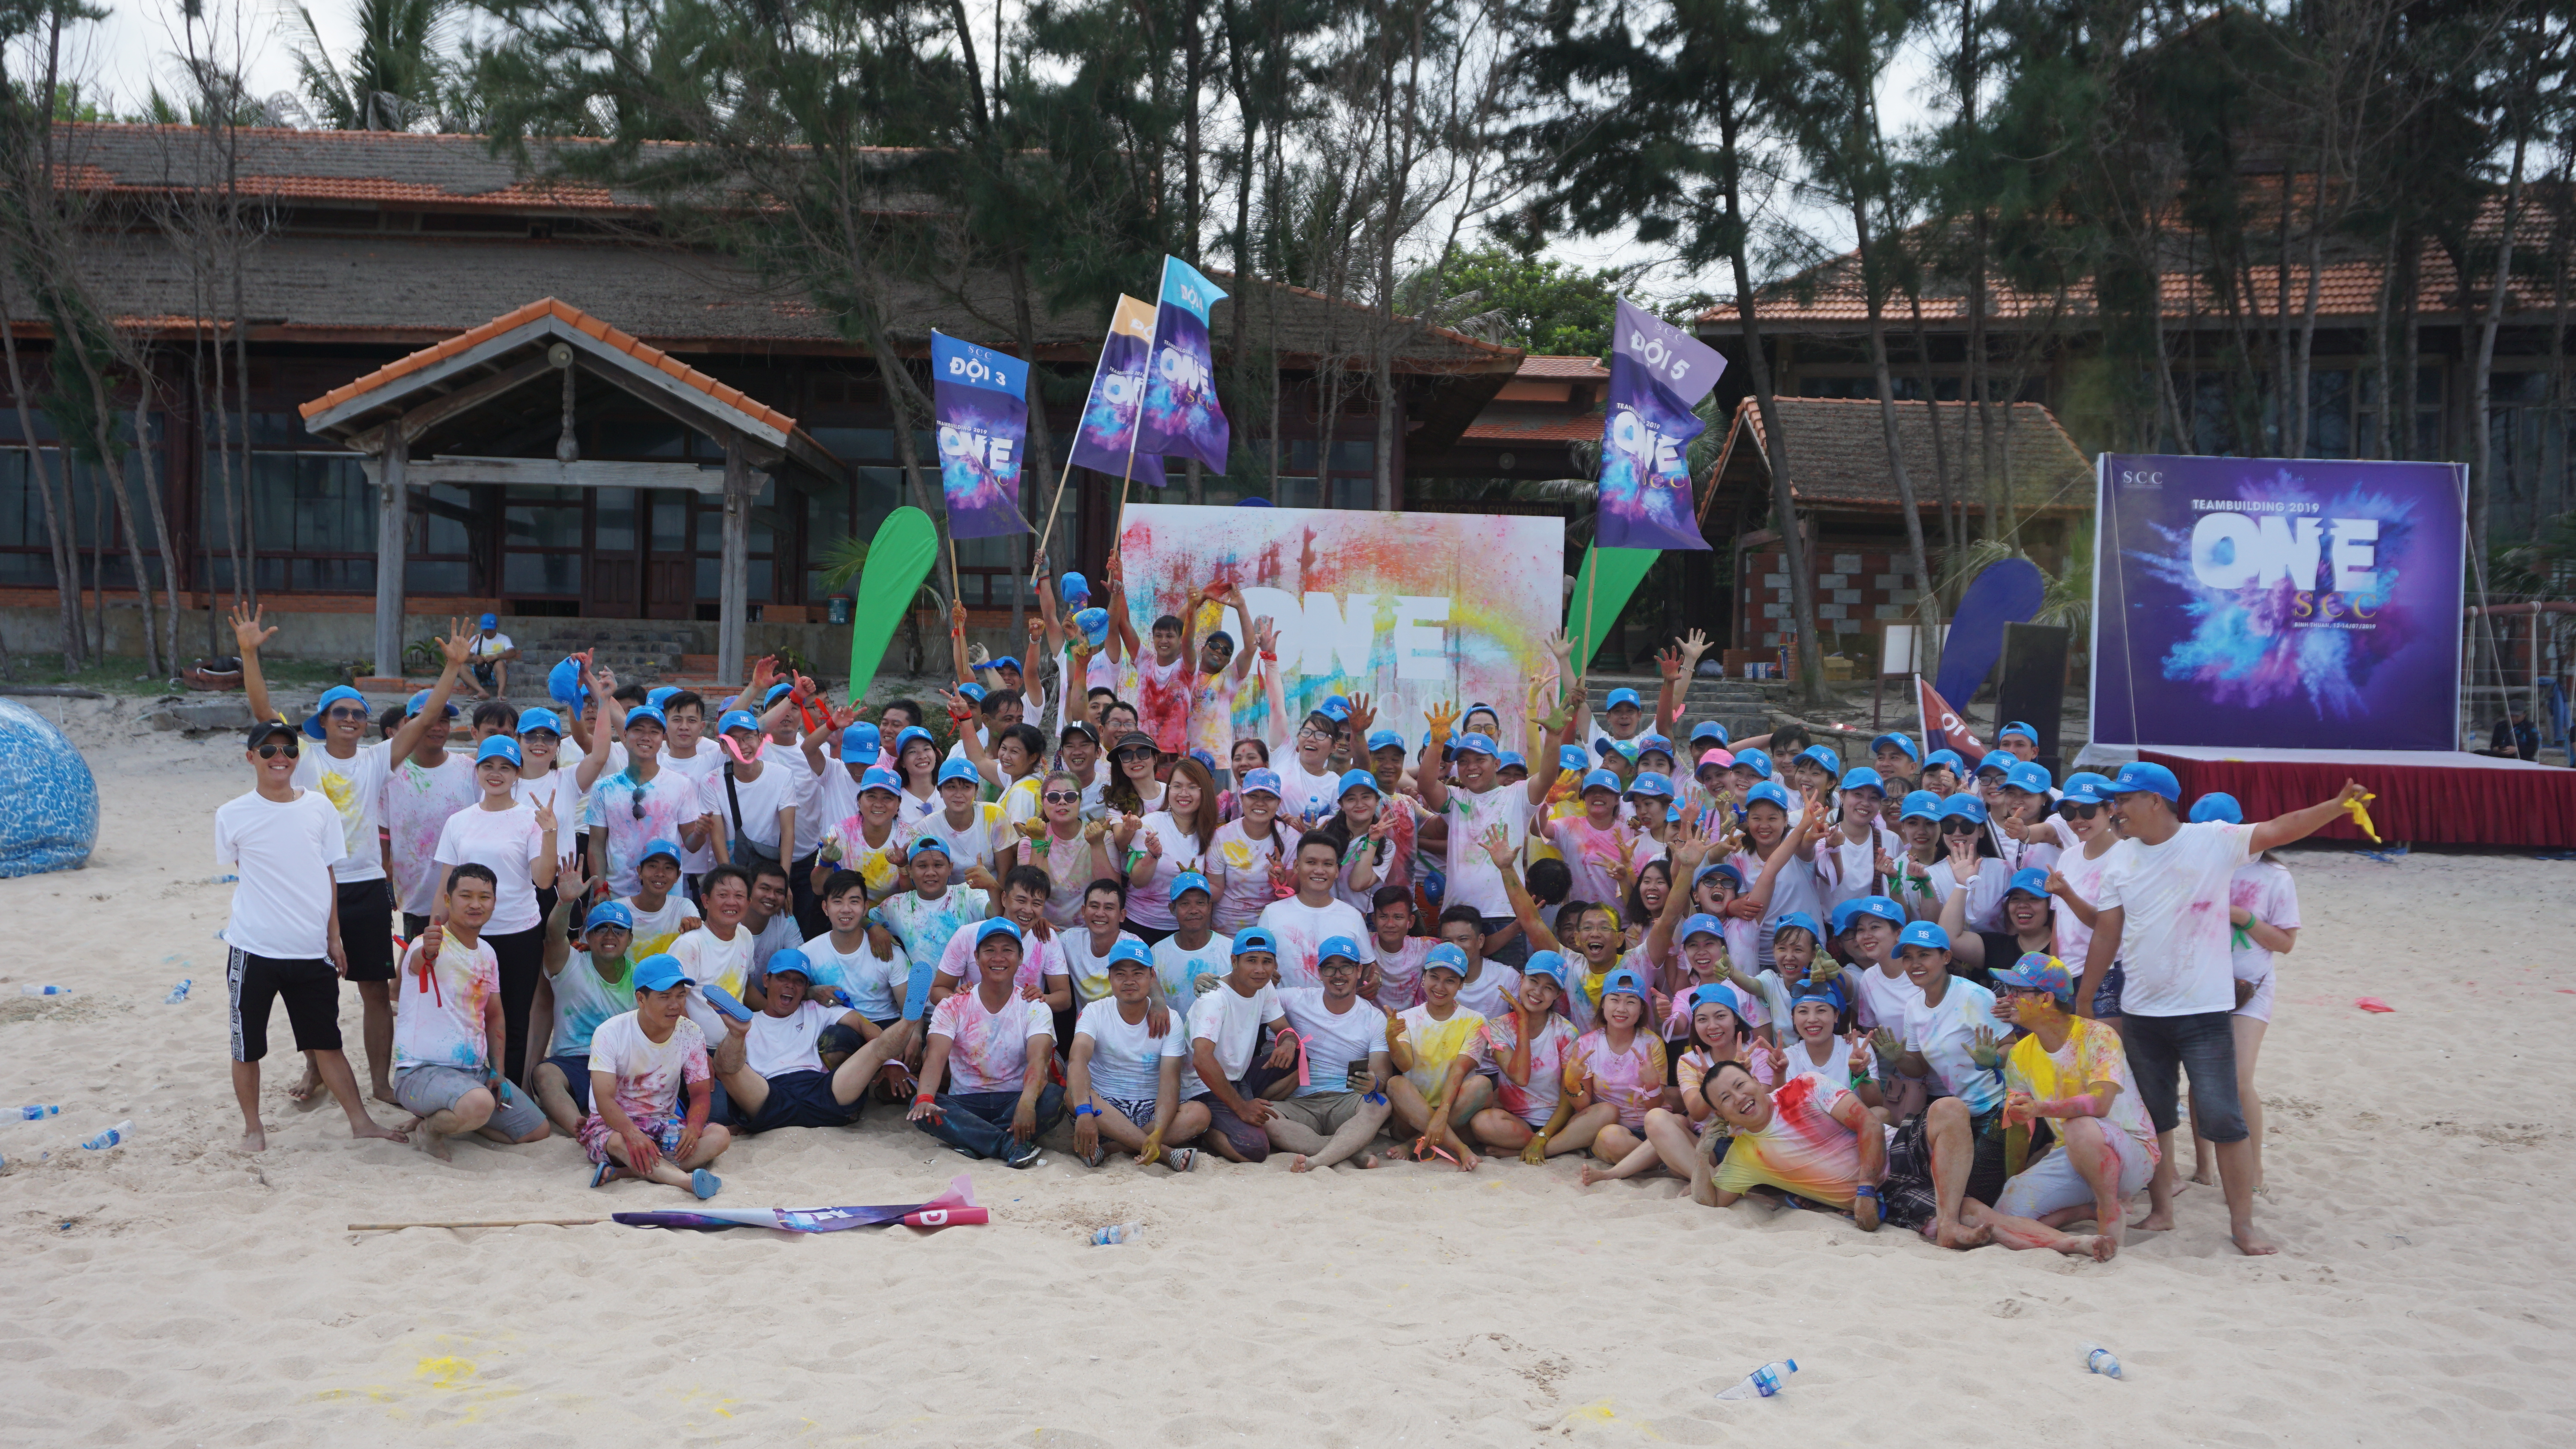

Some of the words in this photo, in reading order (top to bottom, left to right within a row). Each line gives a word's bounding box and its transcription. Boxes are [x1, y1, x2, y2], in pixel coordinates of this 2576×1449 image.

[1655, 322, 1684, 343] SCC
[968, 345, 992, 360] SCC
[1164, 340, 1194, 355] TEAMBUILDING
[1631, 329, 1672, 370] ĐỘI
[1671, 359, 1691, 379] 5
[950, 356, 989, 382] ĐỘI
[996, 371, 1005, 386] 3
[1160, 347, 1211, 396] ONE
[1185, 391, 1214, 410] SCC
[936, 420, 972, 431] TEAMBUILDING
[1646, 421, 1661, 430] 2019
[940, 426, 1013, 471] ONE
[1613, 411, 1684, 473] ONE
[1643, 470, 1685, 489] SCC
[2123, 471, 2163, 484] SCC
[2193, 499, 2285, 512] TEAMBUILDING
[2289, 502, 2320, 513] 2019
[2191, 512, 2379, 592] ONE
[2294, 591, 2376, 618] SCC
[1756, 758, 1764, 766] BS
[2020, 964, 2029, 973] BS
